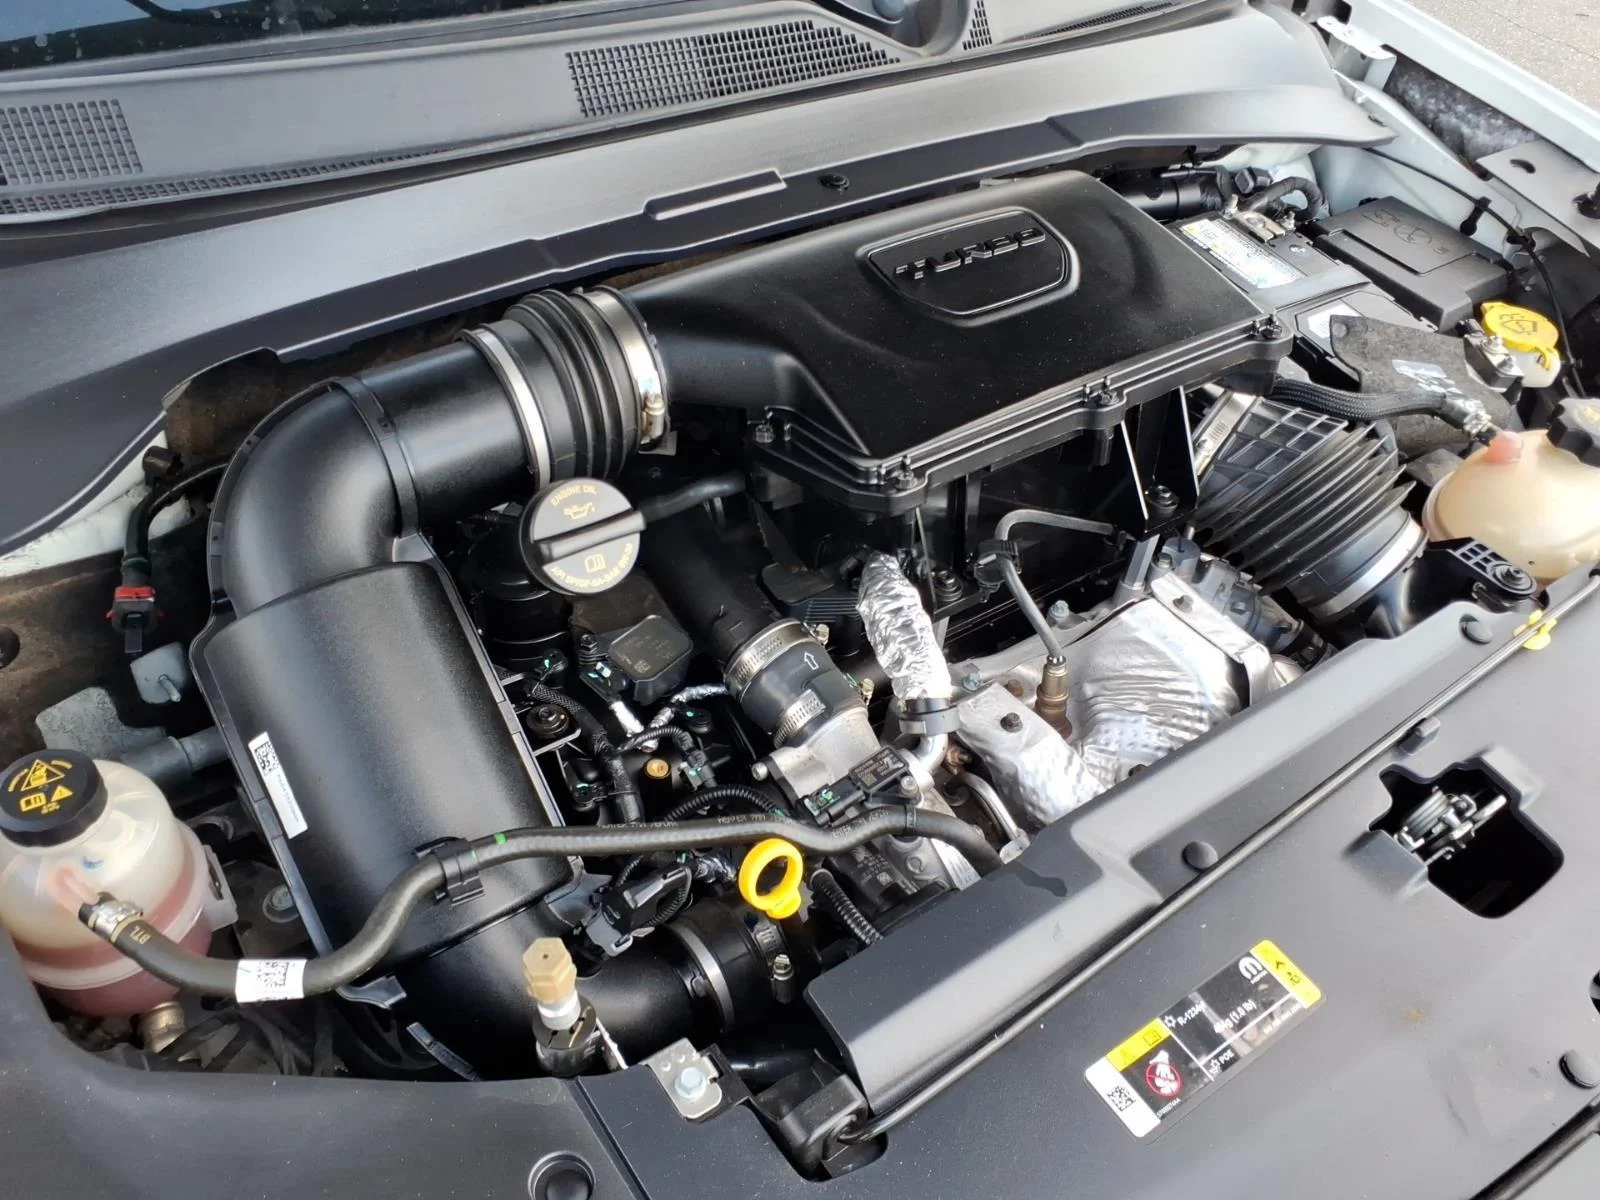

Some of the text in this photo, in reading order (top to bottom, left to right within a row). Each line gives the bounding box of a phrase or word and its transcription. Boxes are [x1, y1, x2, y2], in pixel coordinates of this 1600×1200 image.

[895, 227, 1046, 279] TURBO
[551, 485, 597, 506] ENGINE OIL
[1218, 1049, 1235, 1066] POE
